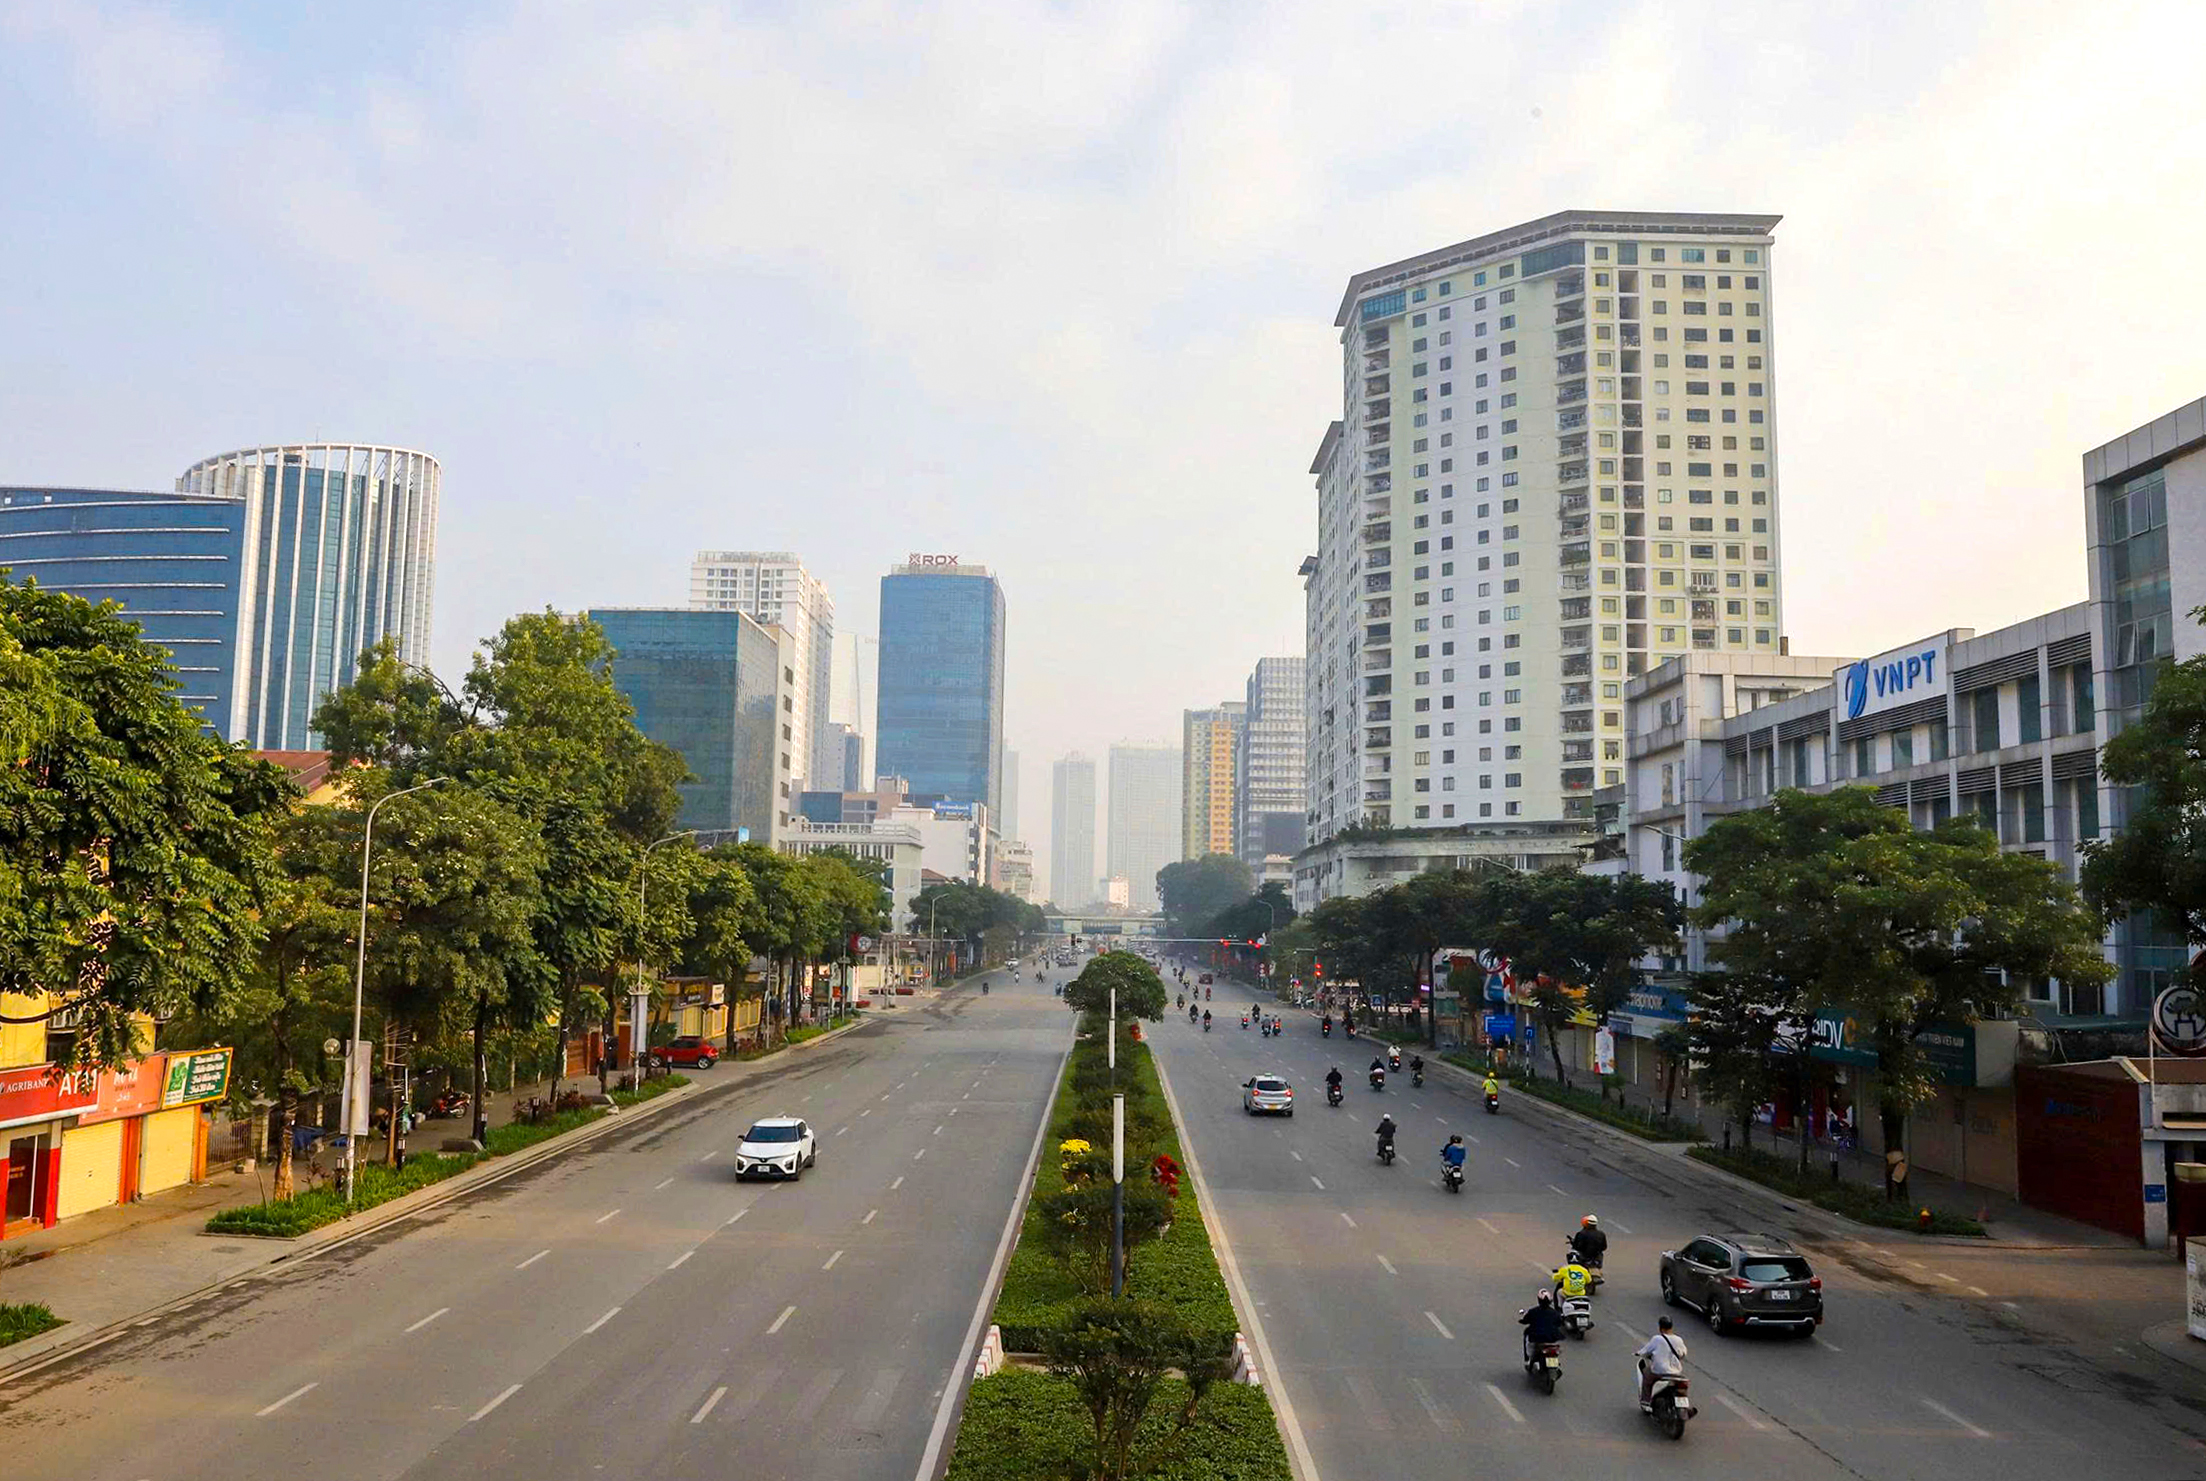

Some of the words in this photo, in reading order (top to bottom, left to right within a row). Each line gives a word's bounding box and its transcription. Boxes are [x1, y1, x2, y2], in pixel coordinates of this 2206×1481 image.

[922, 554, 958, 566] ROX
[1873, 649, 1936, 698] VNPT
[1811, 1018, 1844, 1050] BIDV
